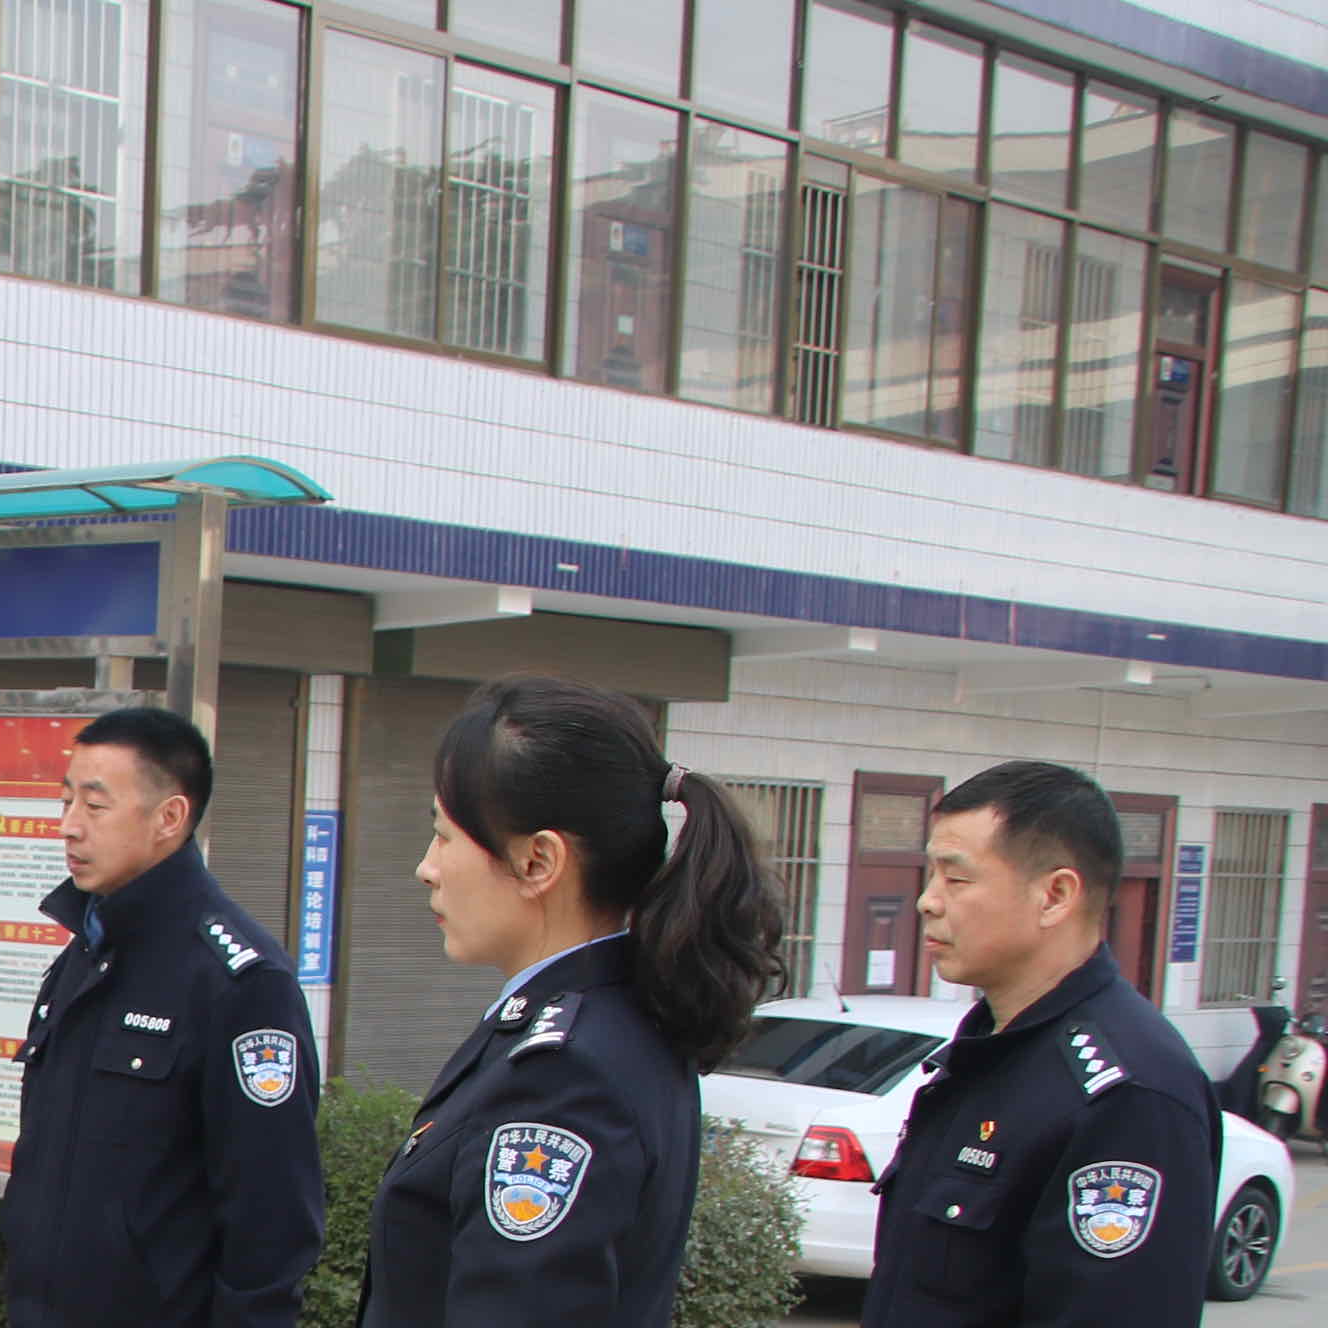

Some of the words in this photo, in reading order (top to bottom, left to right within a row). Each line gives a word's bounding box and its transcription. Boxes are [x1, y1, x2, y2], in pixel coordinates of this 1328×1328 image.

[498, 1129, 586, 1163] 中华人民共和国
[1075, 1167, 1155, 1190] 中华人民共和国
